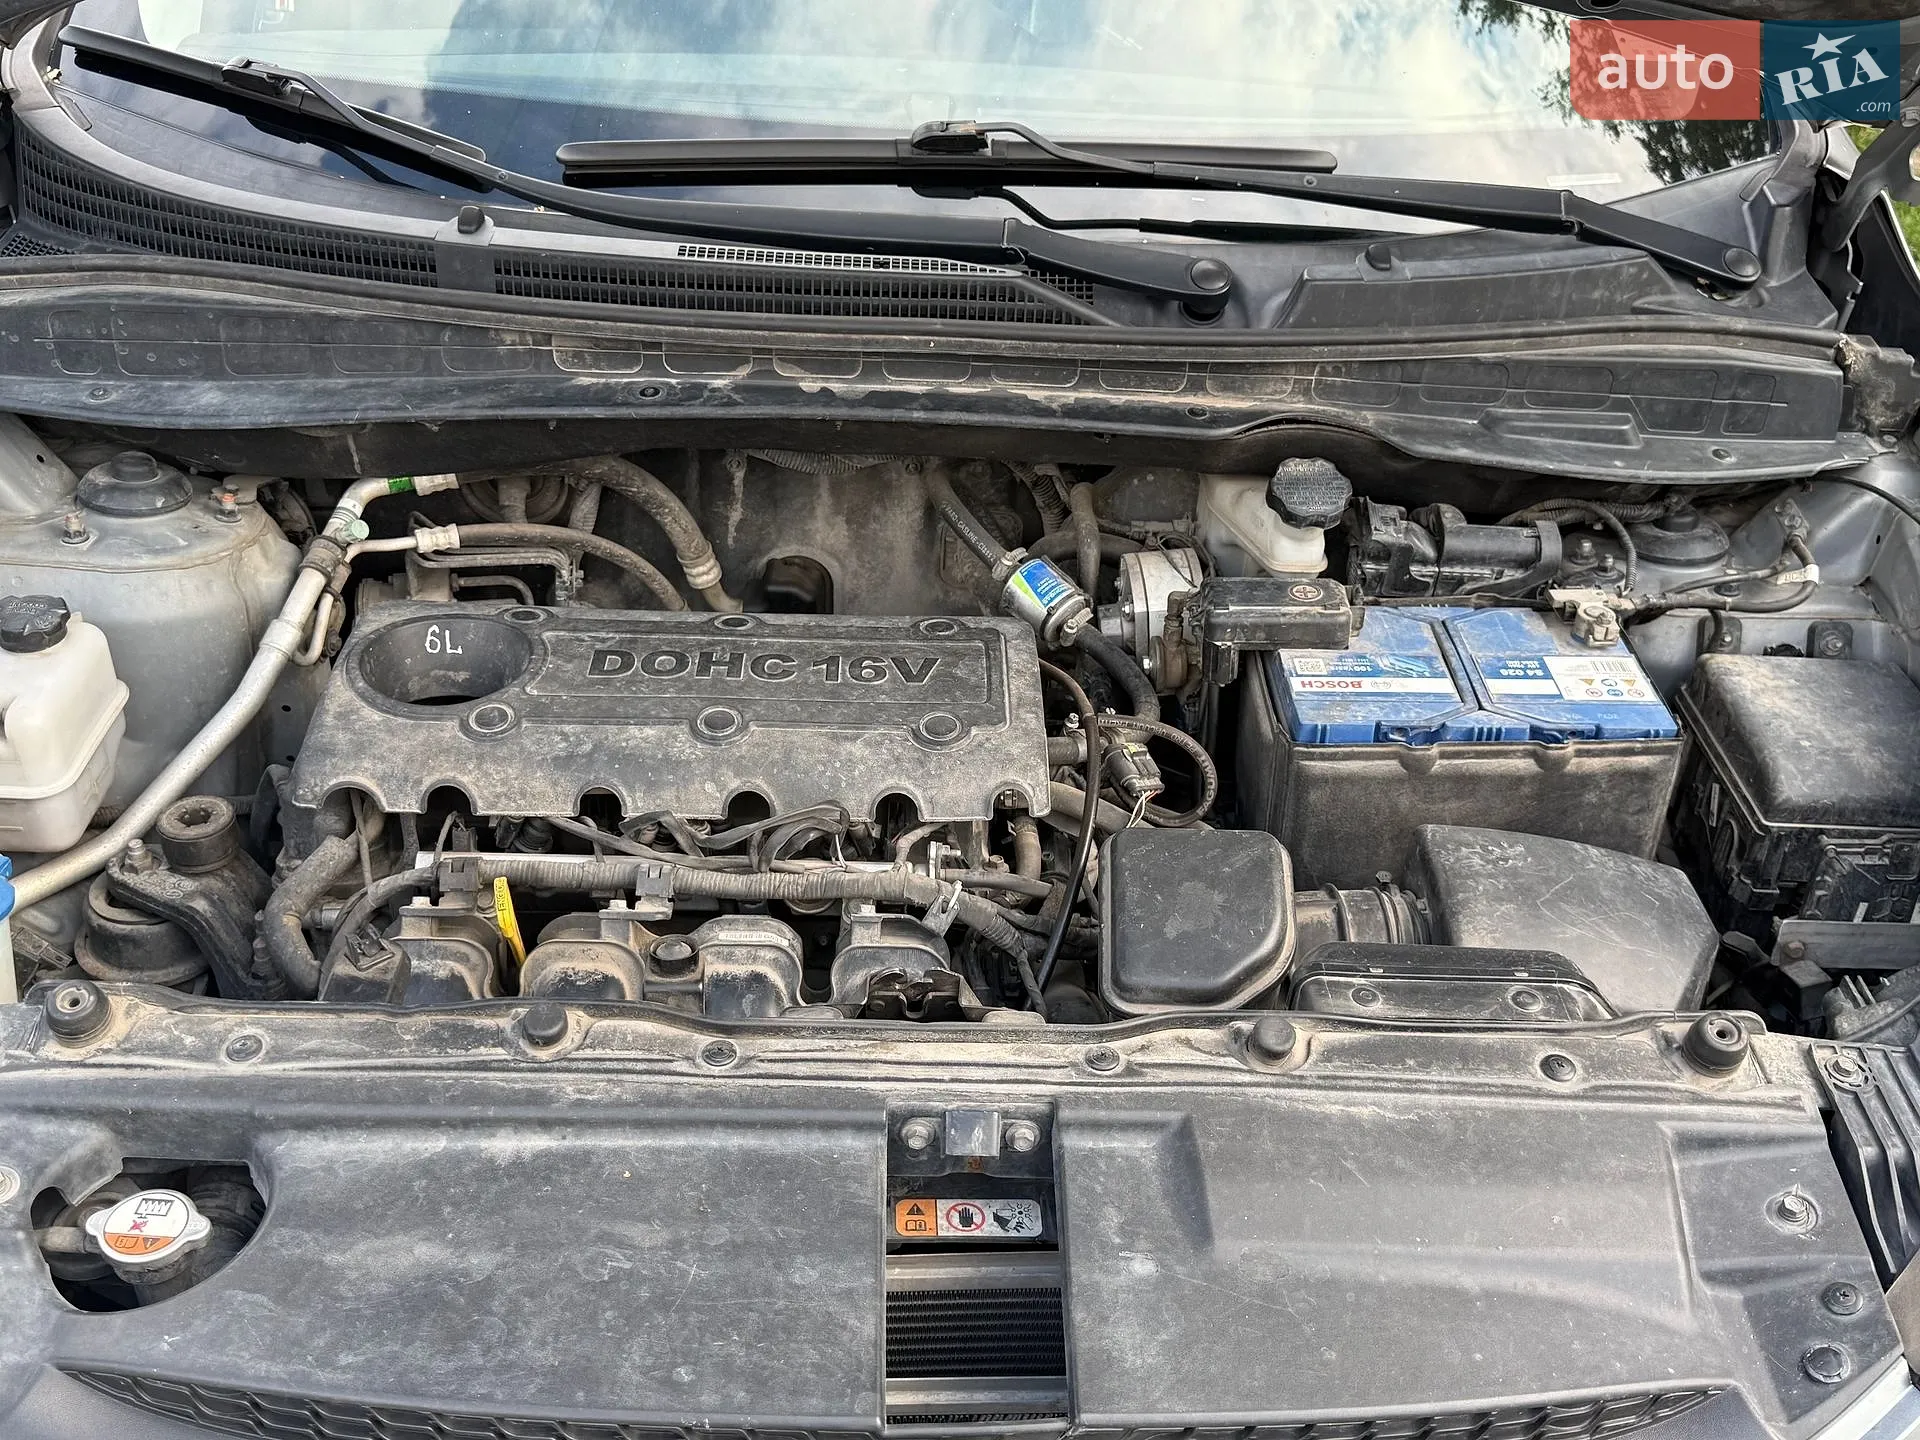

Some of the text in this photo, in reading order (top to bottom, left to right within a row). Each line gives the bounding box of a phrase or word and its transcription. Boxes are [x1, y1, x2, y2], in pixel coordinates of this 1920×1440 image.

[424, 624, 463, 655] 6L
[587, 648, 940, 684] DOHC 16V
[1301, 679, 1363, 690] BOSCH
[1171, 733, 1197, 754] PETRO
[1197, 754, 1217, 816] FAGUMIT
